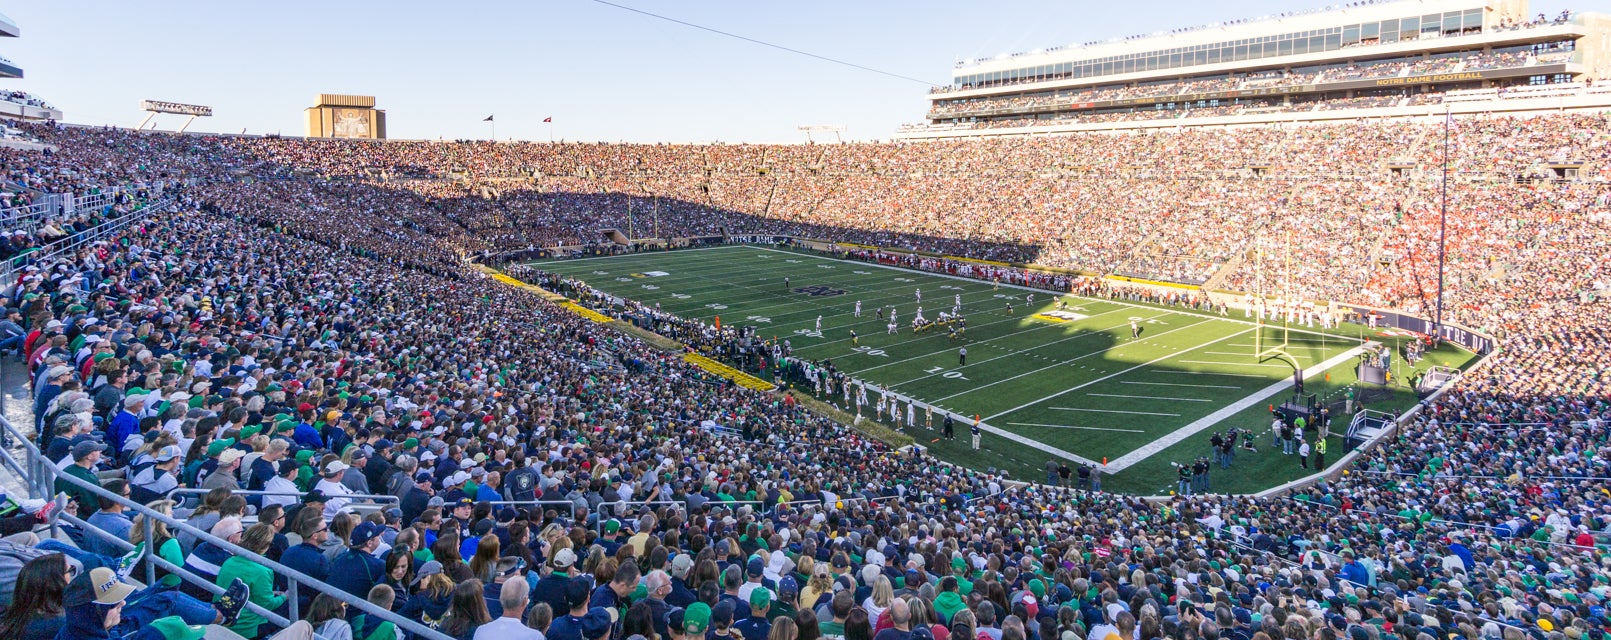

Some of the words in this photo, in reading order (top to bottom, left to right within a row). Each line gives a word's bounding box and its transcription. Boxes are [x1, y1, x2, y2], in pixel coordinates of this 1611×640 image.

[1376, 78, 1405, 86] NOTRE
[1433, 71, 1483, 80] FOOTBALL
[1425, 320, 1466, 346] NTRE
[1472, 334, 1490, 355] DAM
[923, 366, 963, 379] 10
[99, 579, 117, 593] IRI
